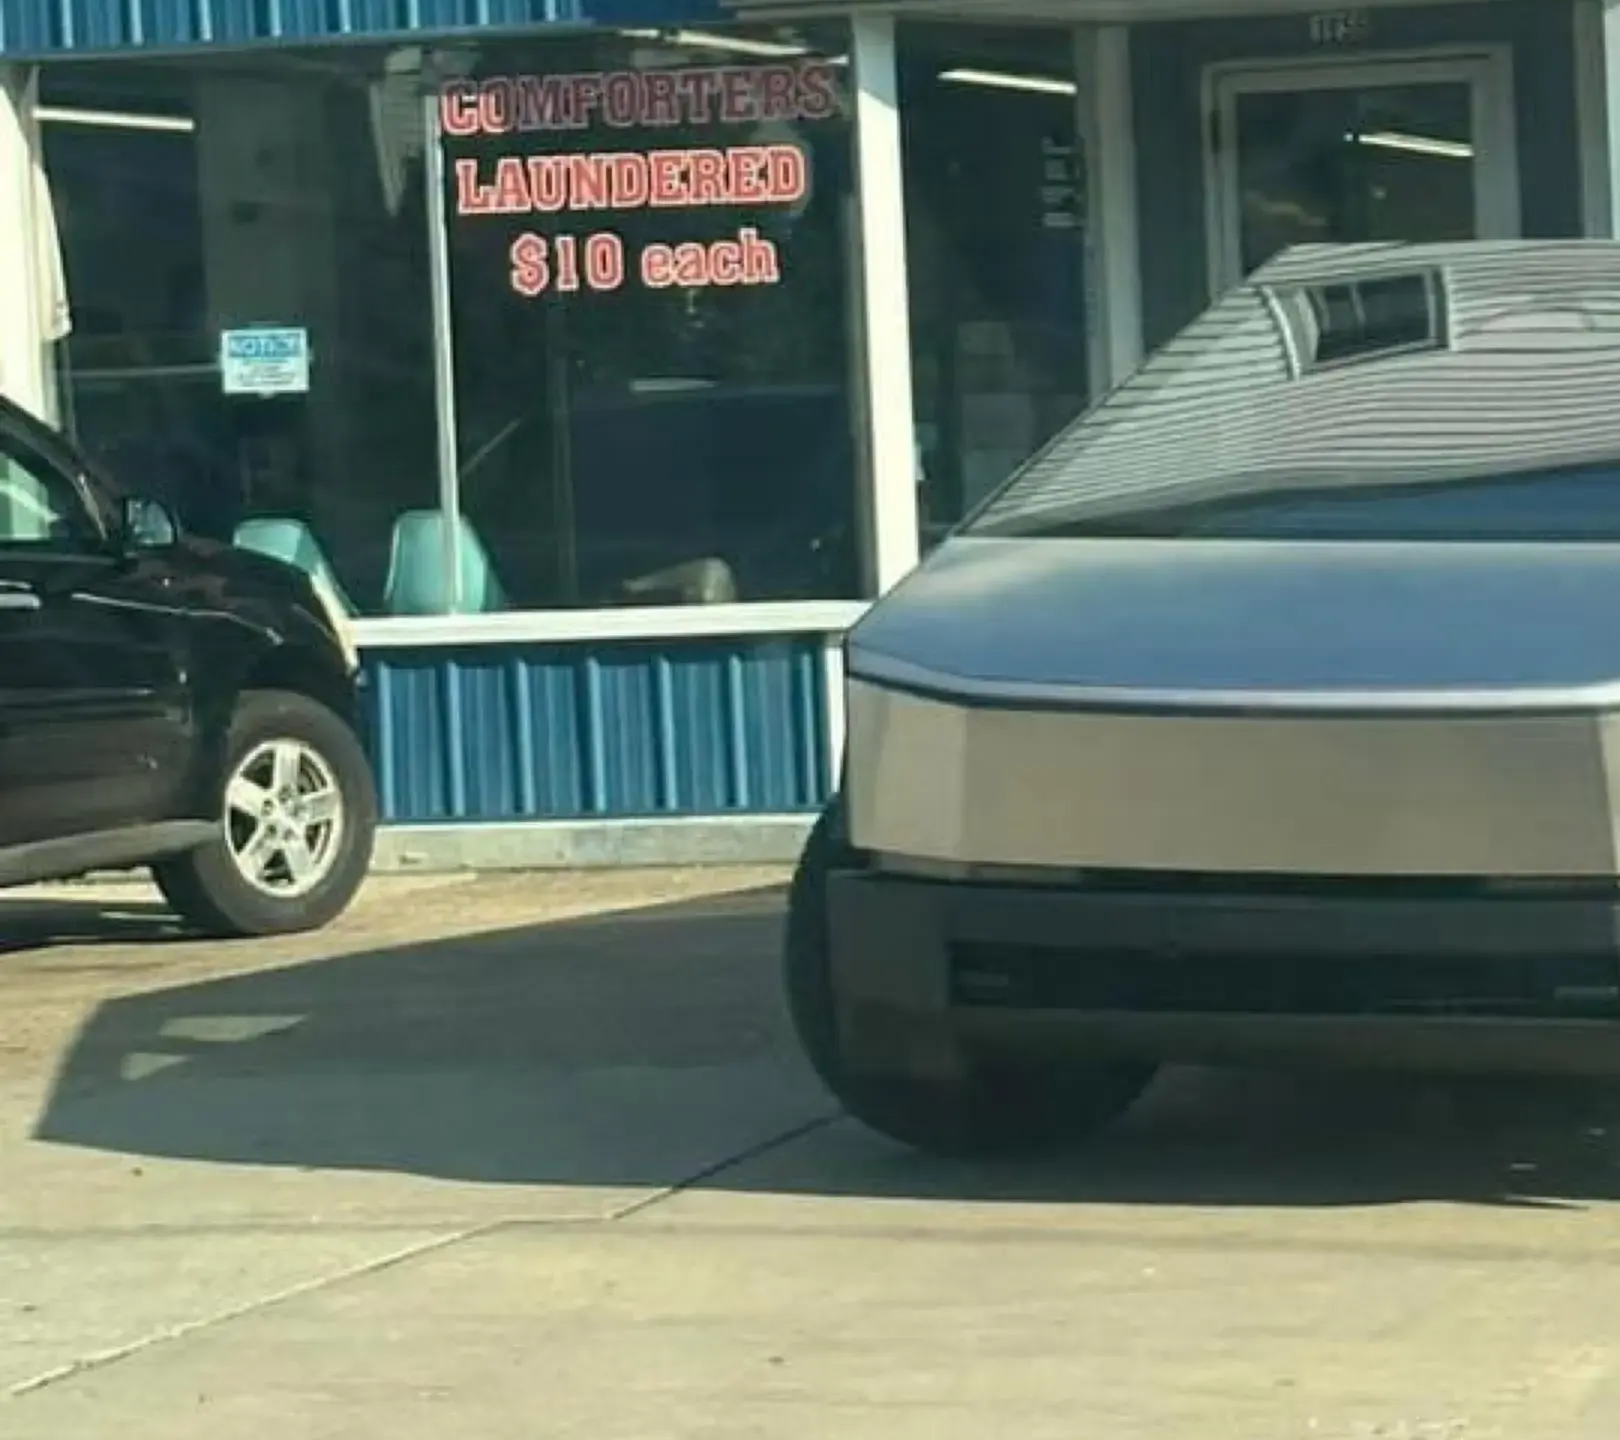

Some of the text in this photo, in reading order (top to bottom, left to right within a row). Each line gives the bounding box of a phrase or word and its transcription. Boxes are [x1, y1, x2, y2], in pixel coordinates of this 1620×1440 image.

[441, 64, 841, 135] COMFORTERS
[456, 143, 806, 214] LAUNDERED
[510, 227, 780, 297] $10 each
